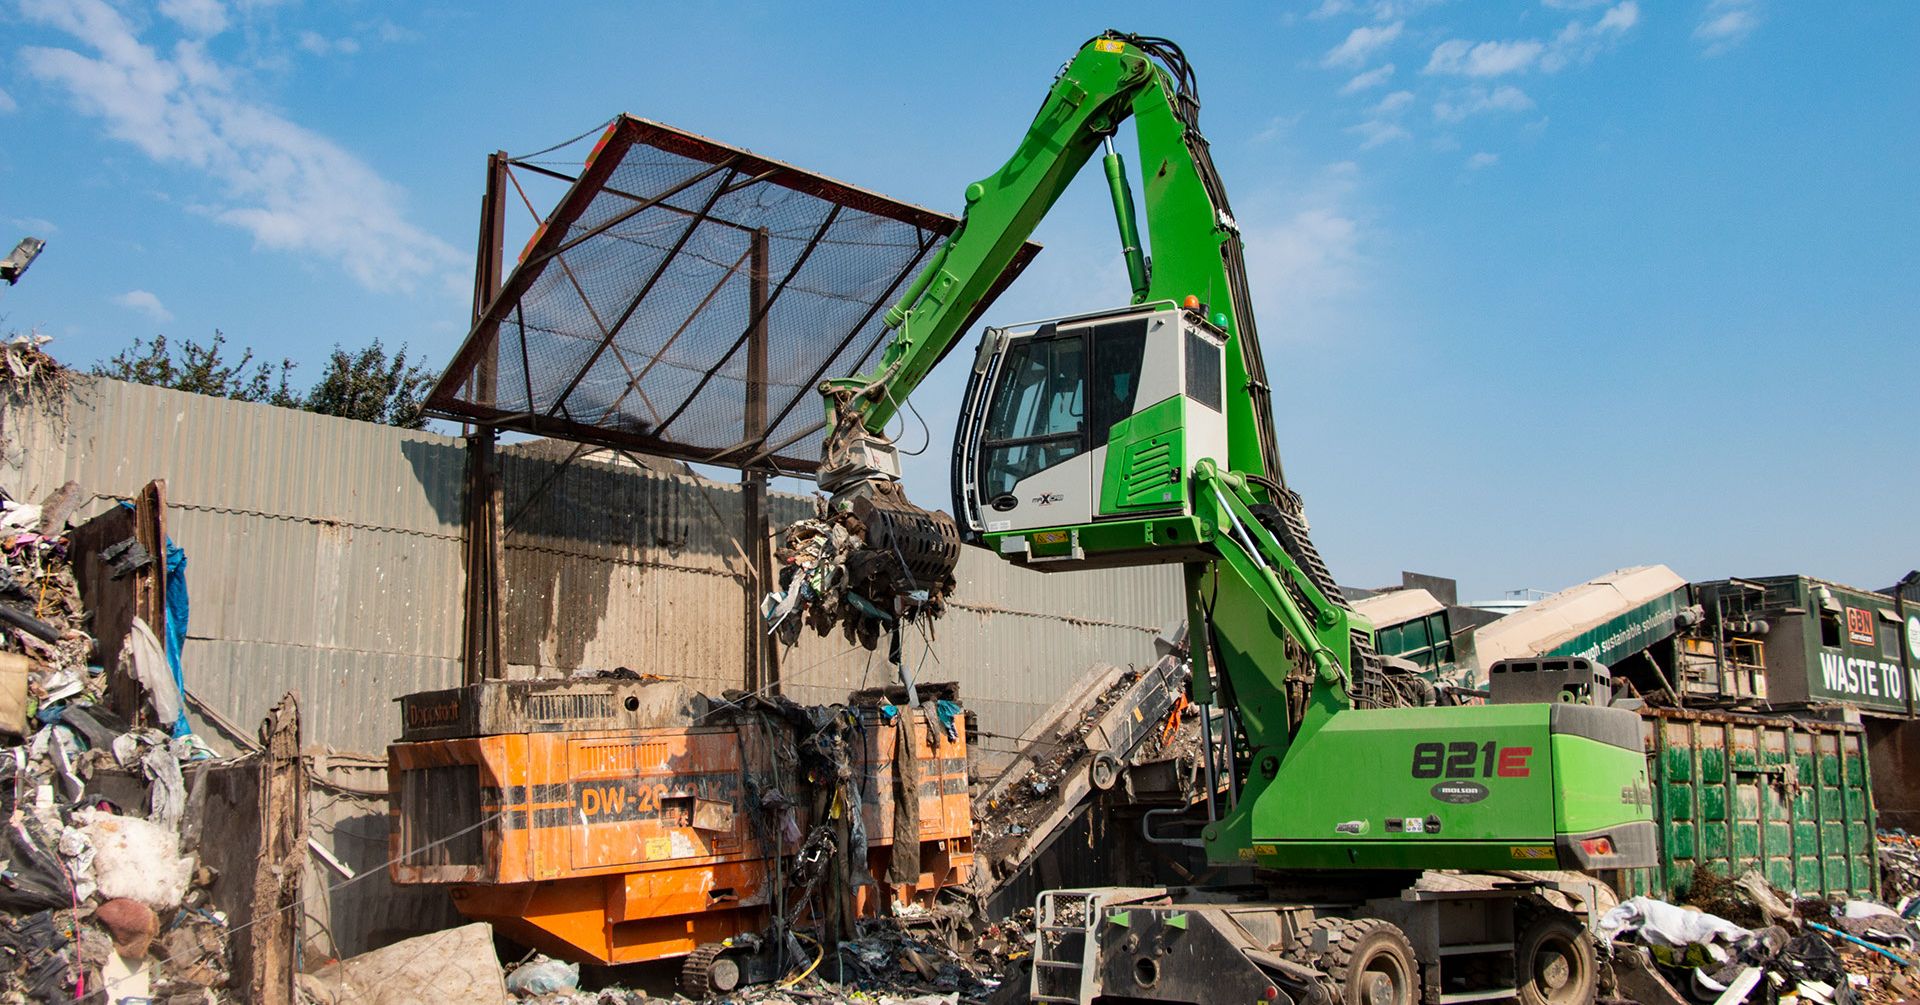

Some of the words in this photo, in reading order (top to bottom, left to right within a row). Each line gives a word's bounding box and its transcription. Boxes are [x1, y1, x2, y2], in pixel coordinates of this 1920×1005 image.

[1601, 622, 1642, 653] sustainable
[1641, 609, 1672, 632] solutions
[1848, 609, 1871, 633] GBN
[1820, 652, 1879, 697] WASTE
[1879, 663, 1901, 699] TO
[1411, 741, 1533, 778] 821E
